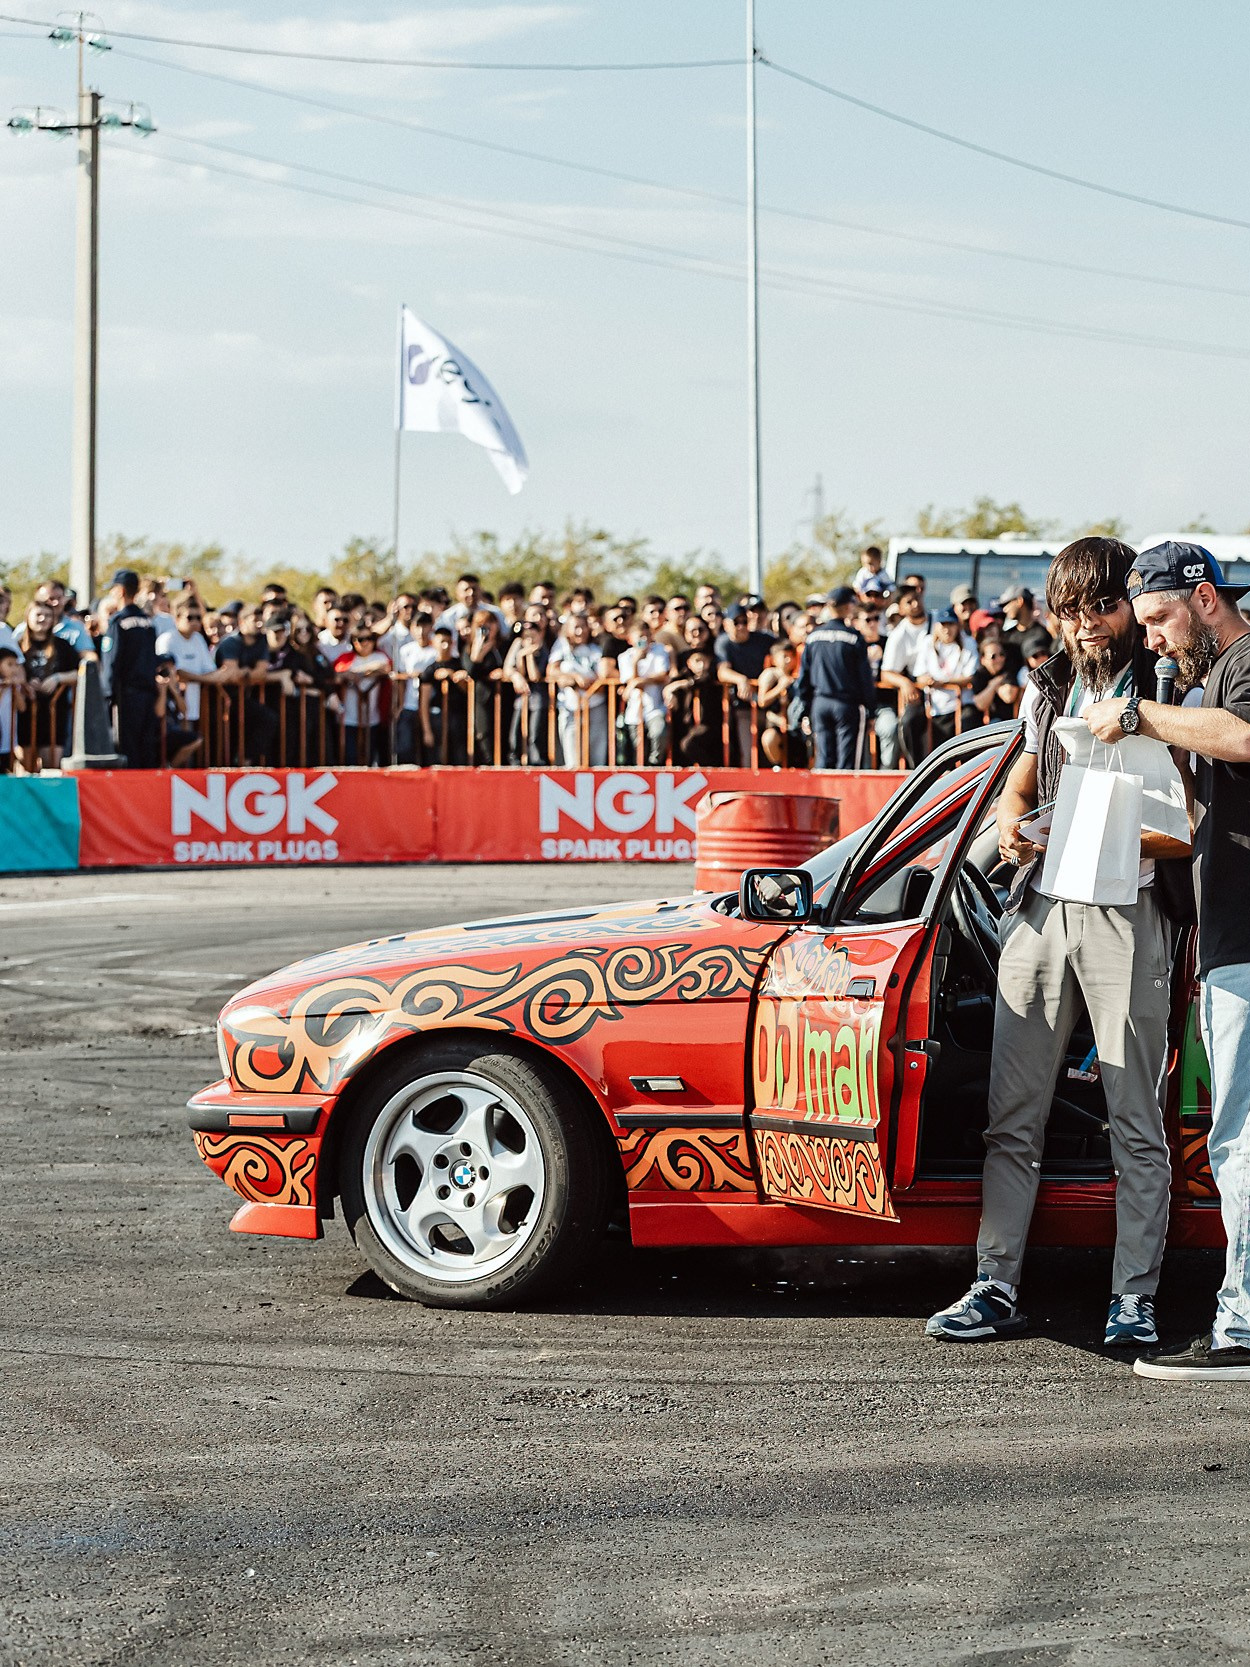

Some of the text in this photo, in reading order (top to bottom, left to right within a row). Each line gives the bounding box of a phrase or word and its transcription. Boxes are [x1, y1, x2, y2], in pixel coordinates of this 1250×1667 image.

[171, 773, 339, 835] NGK
[539, 772, 708, 833] NGK
[173, 840, 339, 862] SPARK PLUGS
[541, 838, 622, 860] SPARK
